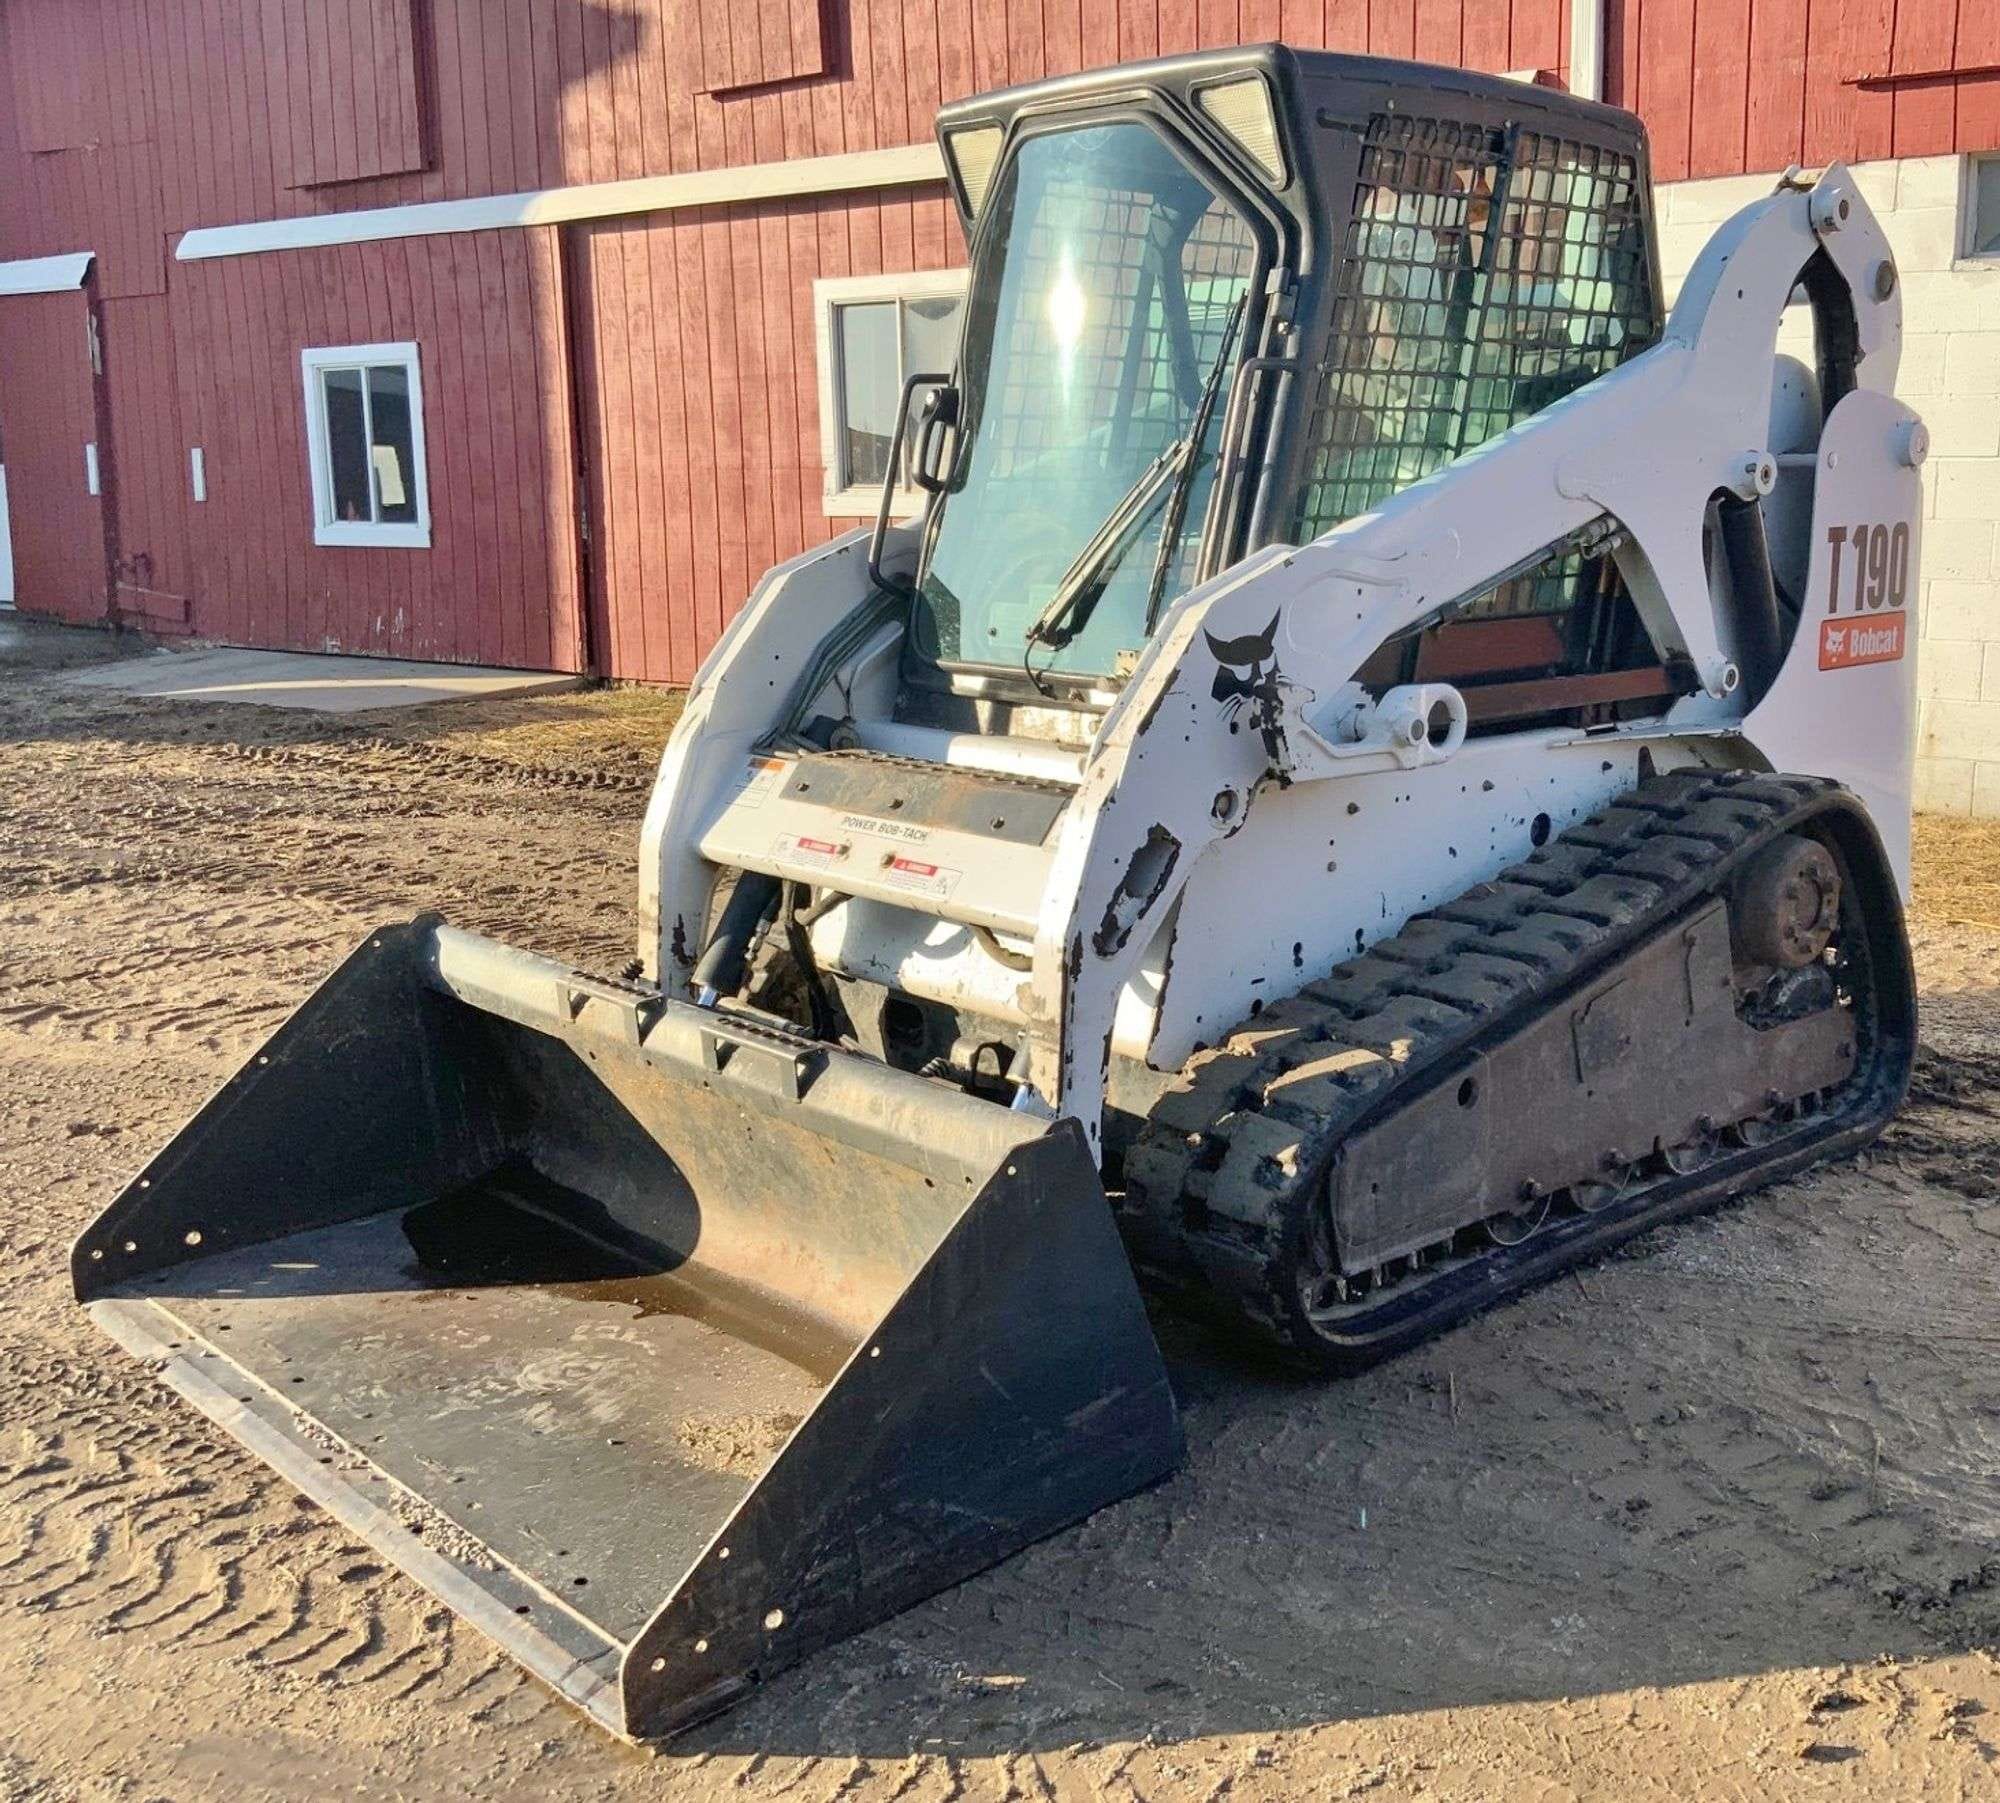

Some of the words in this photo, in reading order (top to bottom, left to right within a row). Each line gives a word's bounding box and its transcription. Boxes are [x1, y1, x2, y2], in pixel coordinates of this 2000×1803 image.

[1828, 522, 1908, 613] T190
[1850, 627, 1898, 657] Bobcat
[842, 816, 876, 831] POWER
[879, 822, 928, 840] BOB-TACH
